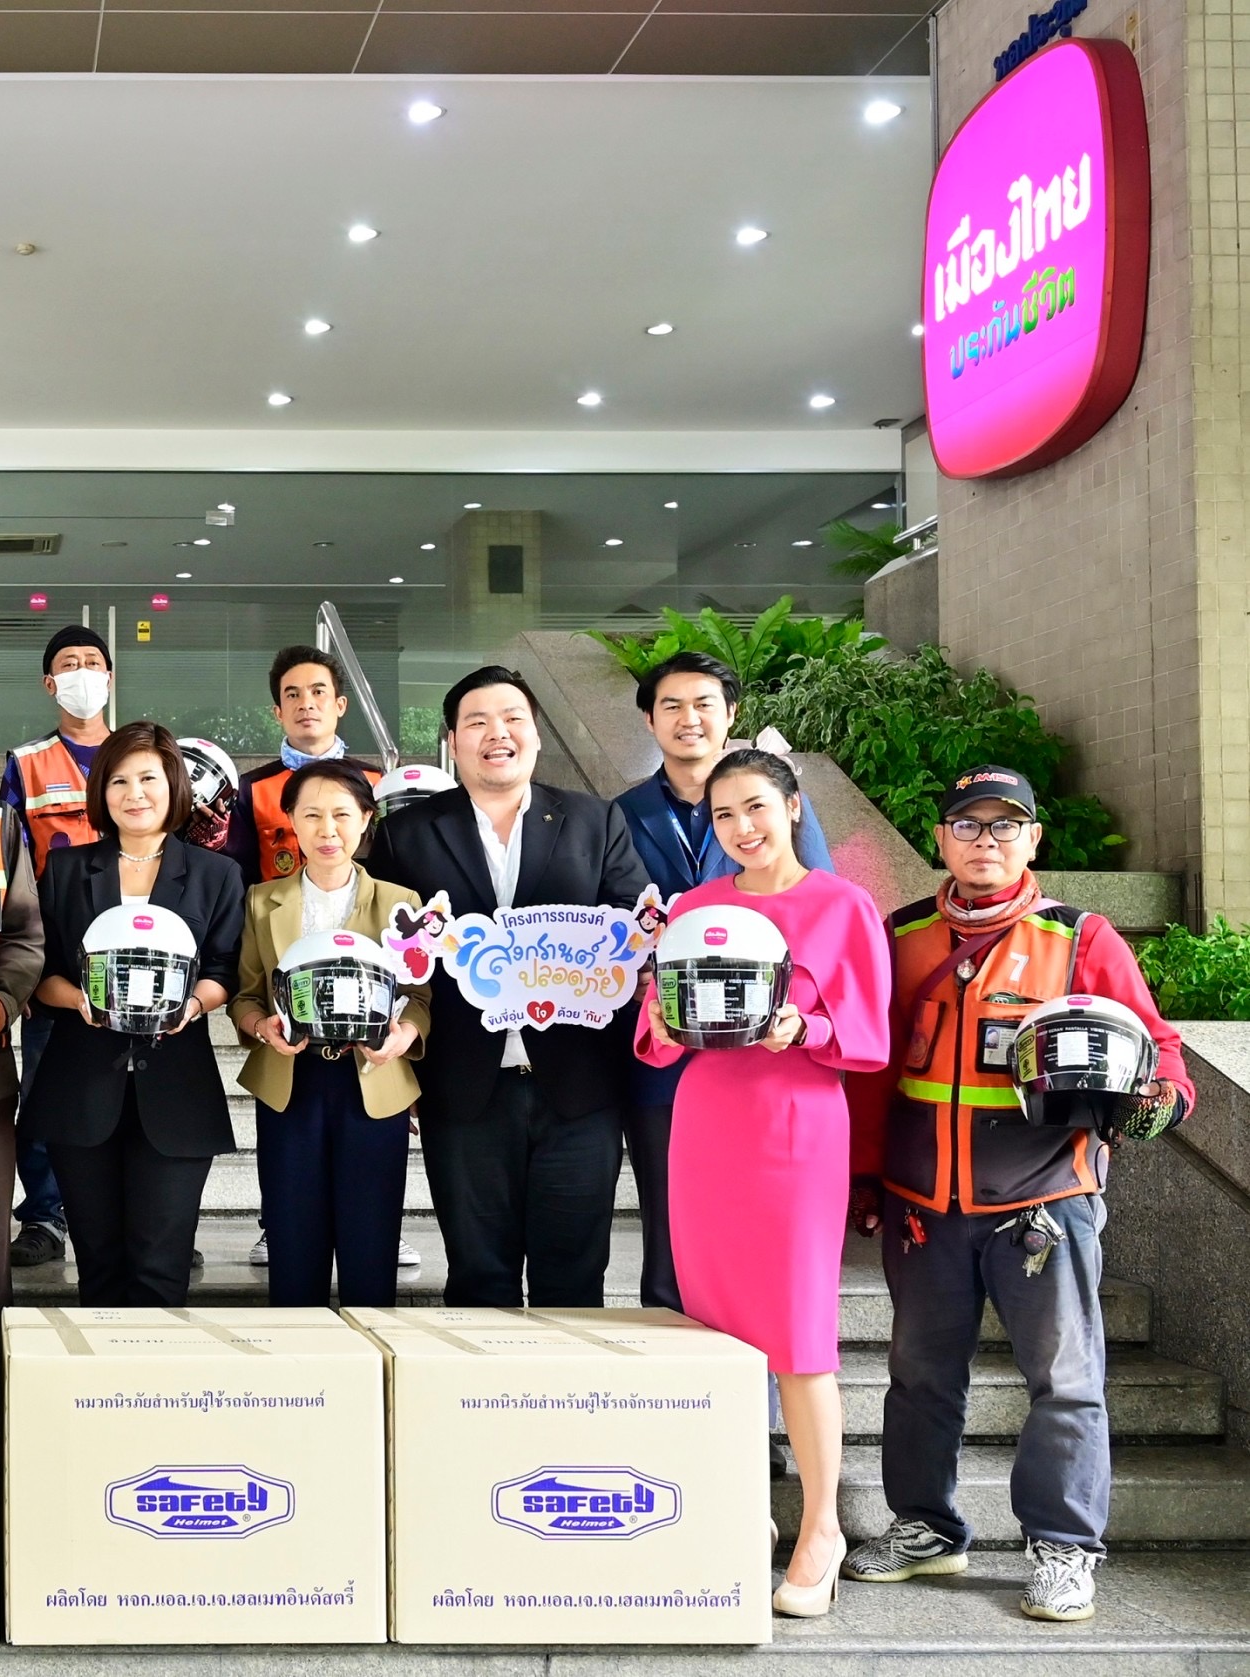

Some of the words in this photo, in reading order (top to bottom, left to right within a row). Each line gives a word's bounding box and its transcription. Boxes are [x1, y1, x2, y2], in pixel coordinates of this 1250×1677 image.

[934, 152, 1091, 322] เมืองไทย
[949, 265, 1075, 380] ประกันชีวิต
[501, 911, 606, 929] โครงการรณรงค์
[470, 930, 607, 994] สงกรานต์
[1010, 953, 1029, 982] 7
[519, 958, 625, 998] ปลอดภัย
[558, 1007, 580, 1019] ด้วย
[74, 1389, 325, 1413] หมวกนิรภัยสำหรับผู้ใช้รถจักรยานยนต์
[460, 1391, 712, 1414] หมวกนิรภัยสำหรับผู้ใช้รถจักรยานยนต์
[173, 1518, 228, 1528] Helmet
[560, 1519, 615, 1529] Helmet
[46, 1587, 107, 1607] ผลิตโดย
[432, 1587, 494, 1608] ผลิตโดย
